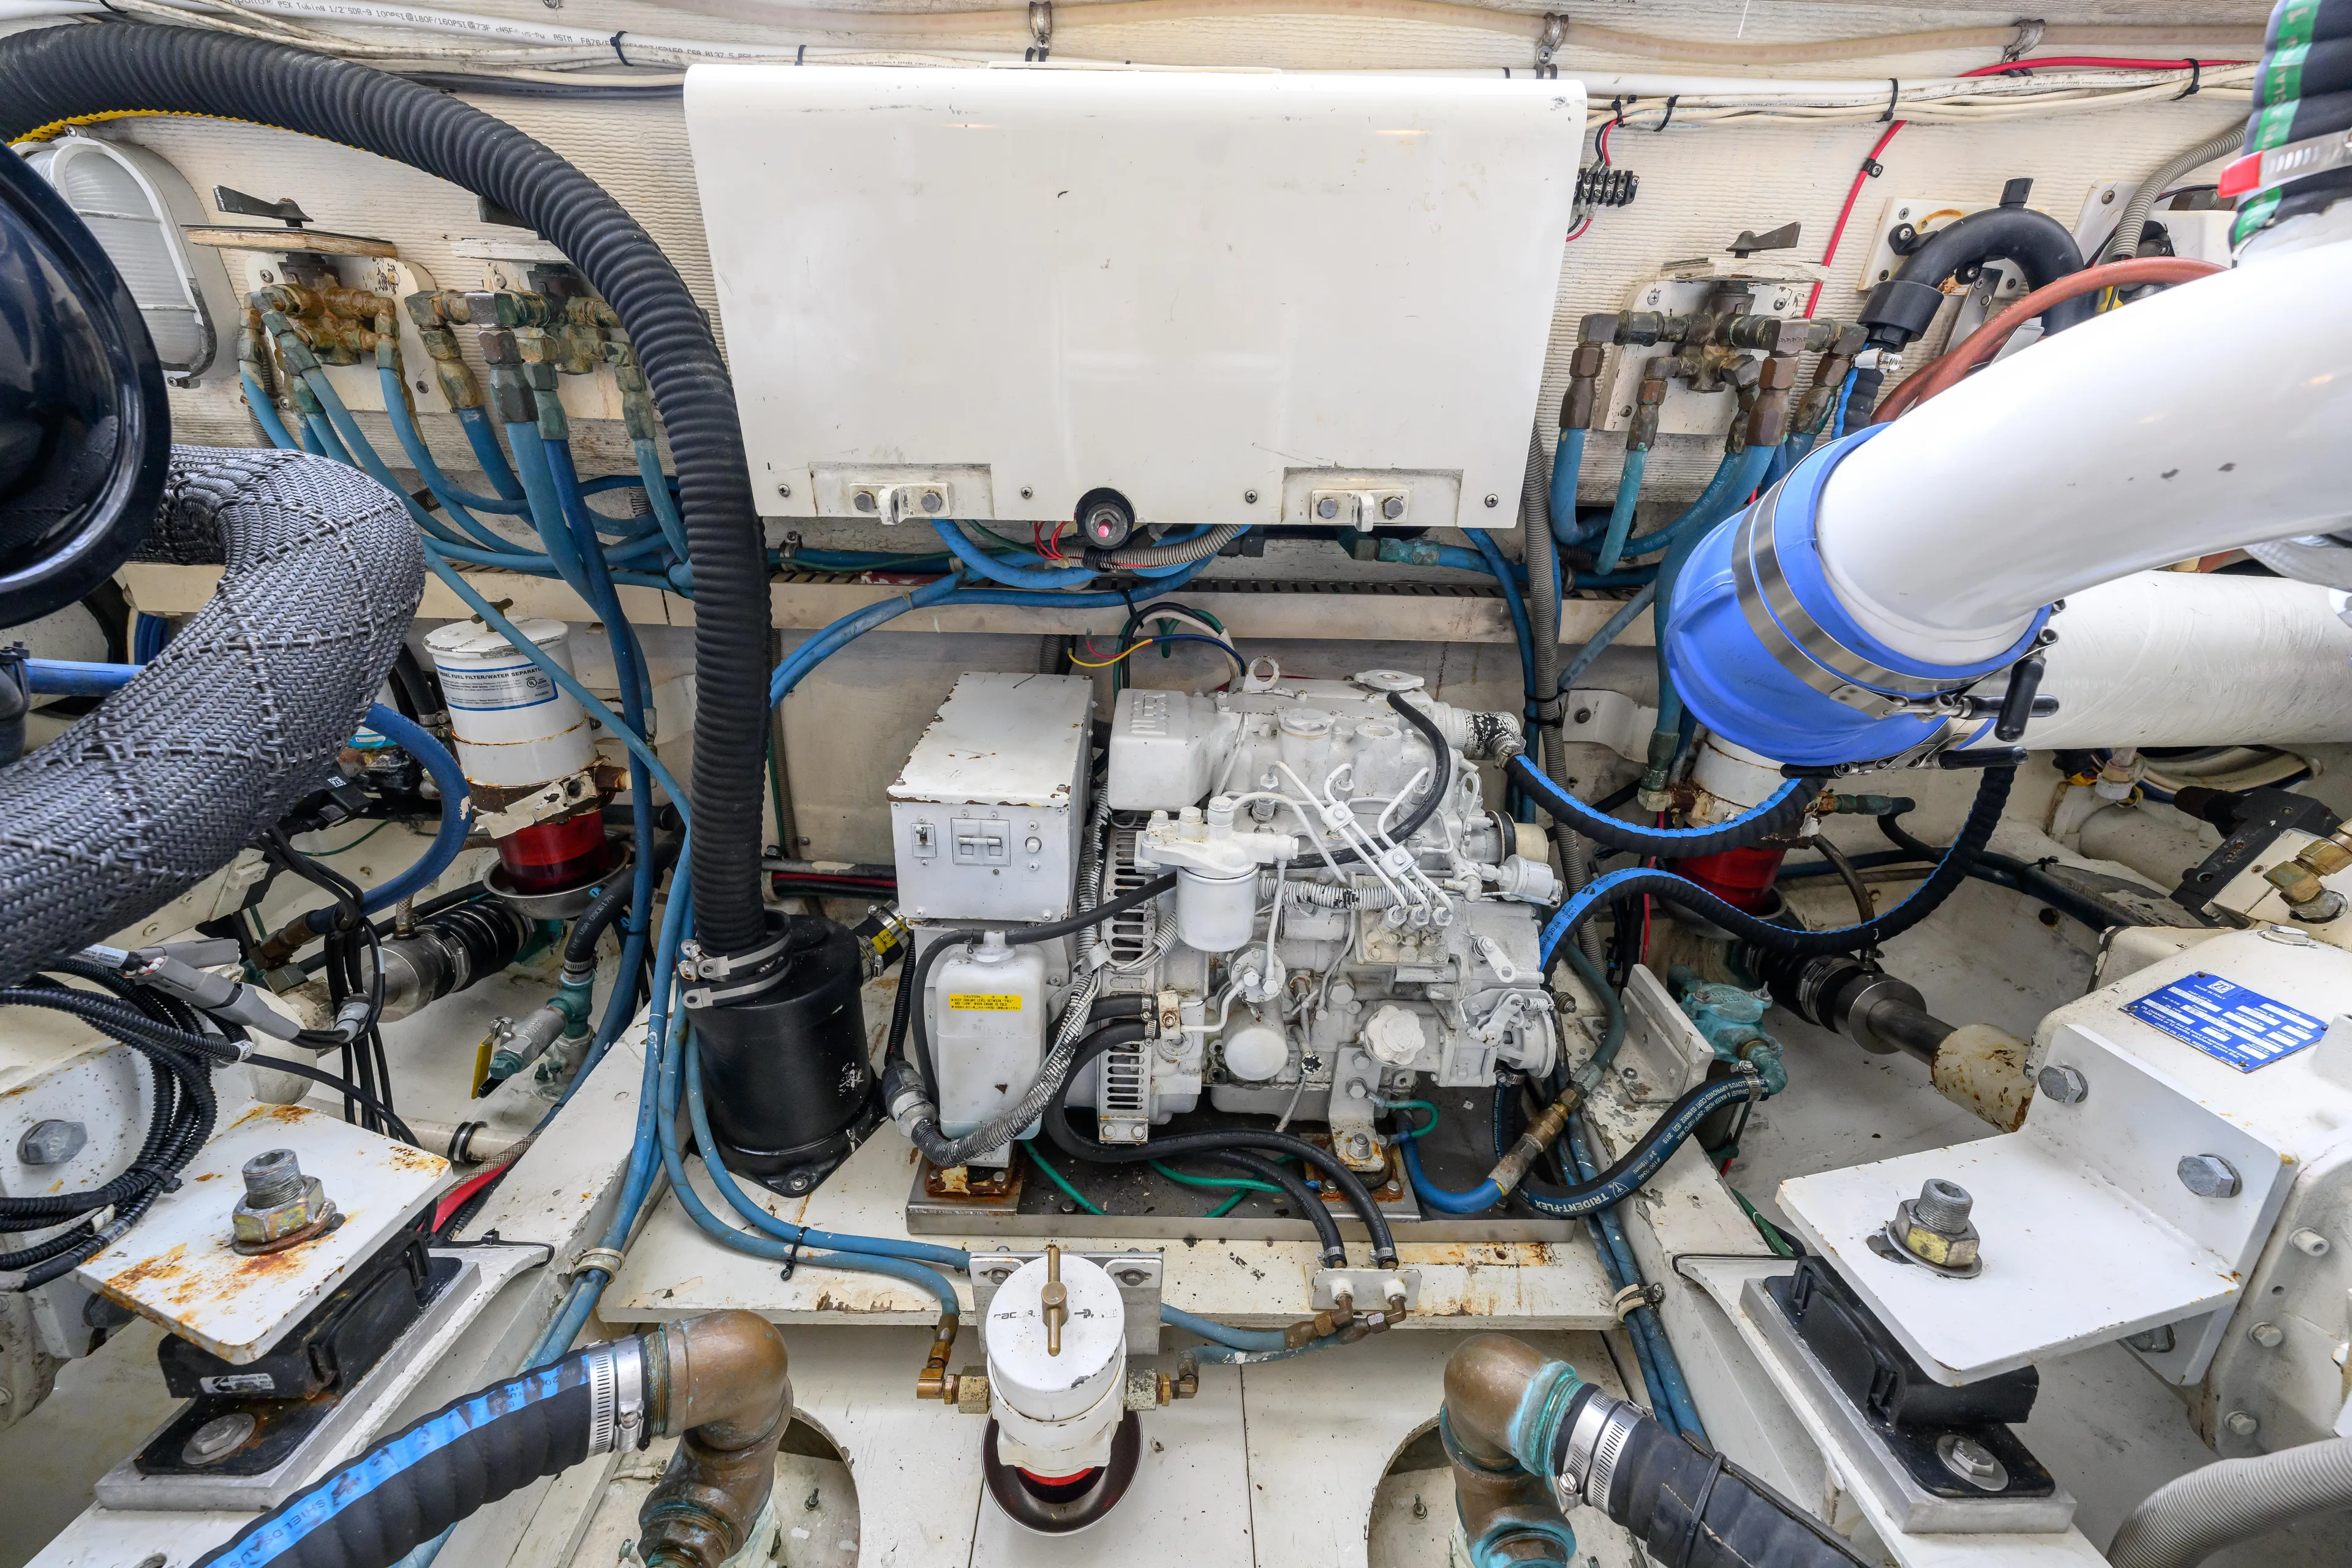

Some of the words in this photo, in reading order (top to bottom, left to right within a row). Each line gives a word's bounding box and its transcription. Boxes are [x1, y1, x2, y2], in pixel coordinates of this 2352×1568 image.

[296, 2, 325, 11] Tubing
[553, 34, 573, 43] ASTM
[1709, 480, 1725, 496] TYPE
[1687, 507, 1702, 520] HOSE
[1596, 872, 1619, 886] EXOFLEX
[1566, 908, 1577, 920] ITALY
[579, 922, 590, 935] USA
[1549, 921, 1561, 935] 2024
[98, 956, 122, 965] CONTROL
[2235, 1012, 2260, 1023] CUSTOMER
[2147, 1009, 2168, 1019] CHANGE:
[2205, 1038, 2228, 1049] operation
[2239, 1026, 2256, 1035] Medium
[2154, 1022, 2171, 1031] CHECK
[2177, 1034, 2193, 1042] LEVEL
[2190, 1041, 2211, 1052] WEEKLY
[2190, 1034, 2213, 1046] whichever
[2211, 1044, 2228, 1053] occurs
[1706, 1085, 1729, 1101] APPROVED
[1731, 1088, 1750, 1098] EXHAUST
[1694, 1098, 1707, 1109] CERT
[1705, 1100, 1719, 1112] HOSE
[1717, 1095, 1728, 1105] WATER
[1672, 1121, 1682, 1133] (E2)
[1663, 1133, 1673, 1145] 2019
[1676, 1128, 1686, 1140] MAX.
[1297, 1142, 1311, 1152] MARINE
[1312, 1149, 1329, 1163] PREMIUM
[1649, 1150, 1657, 1161] 3/4"
[1632, 1159, 1649, 1175] (19mm)
[1534, 1193, 1610, 1213] TRIDENT-FLEX
[1638, 1156, 1660, 1181] #100-0340
[1302, 1201, 1311, 1210] TYPE
